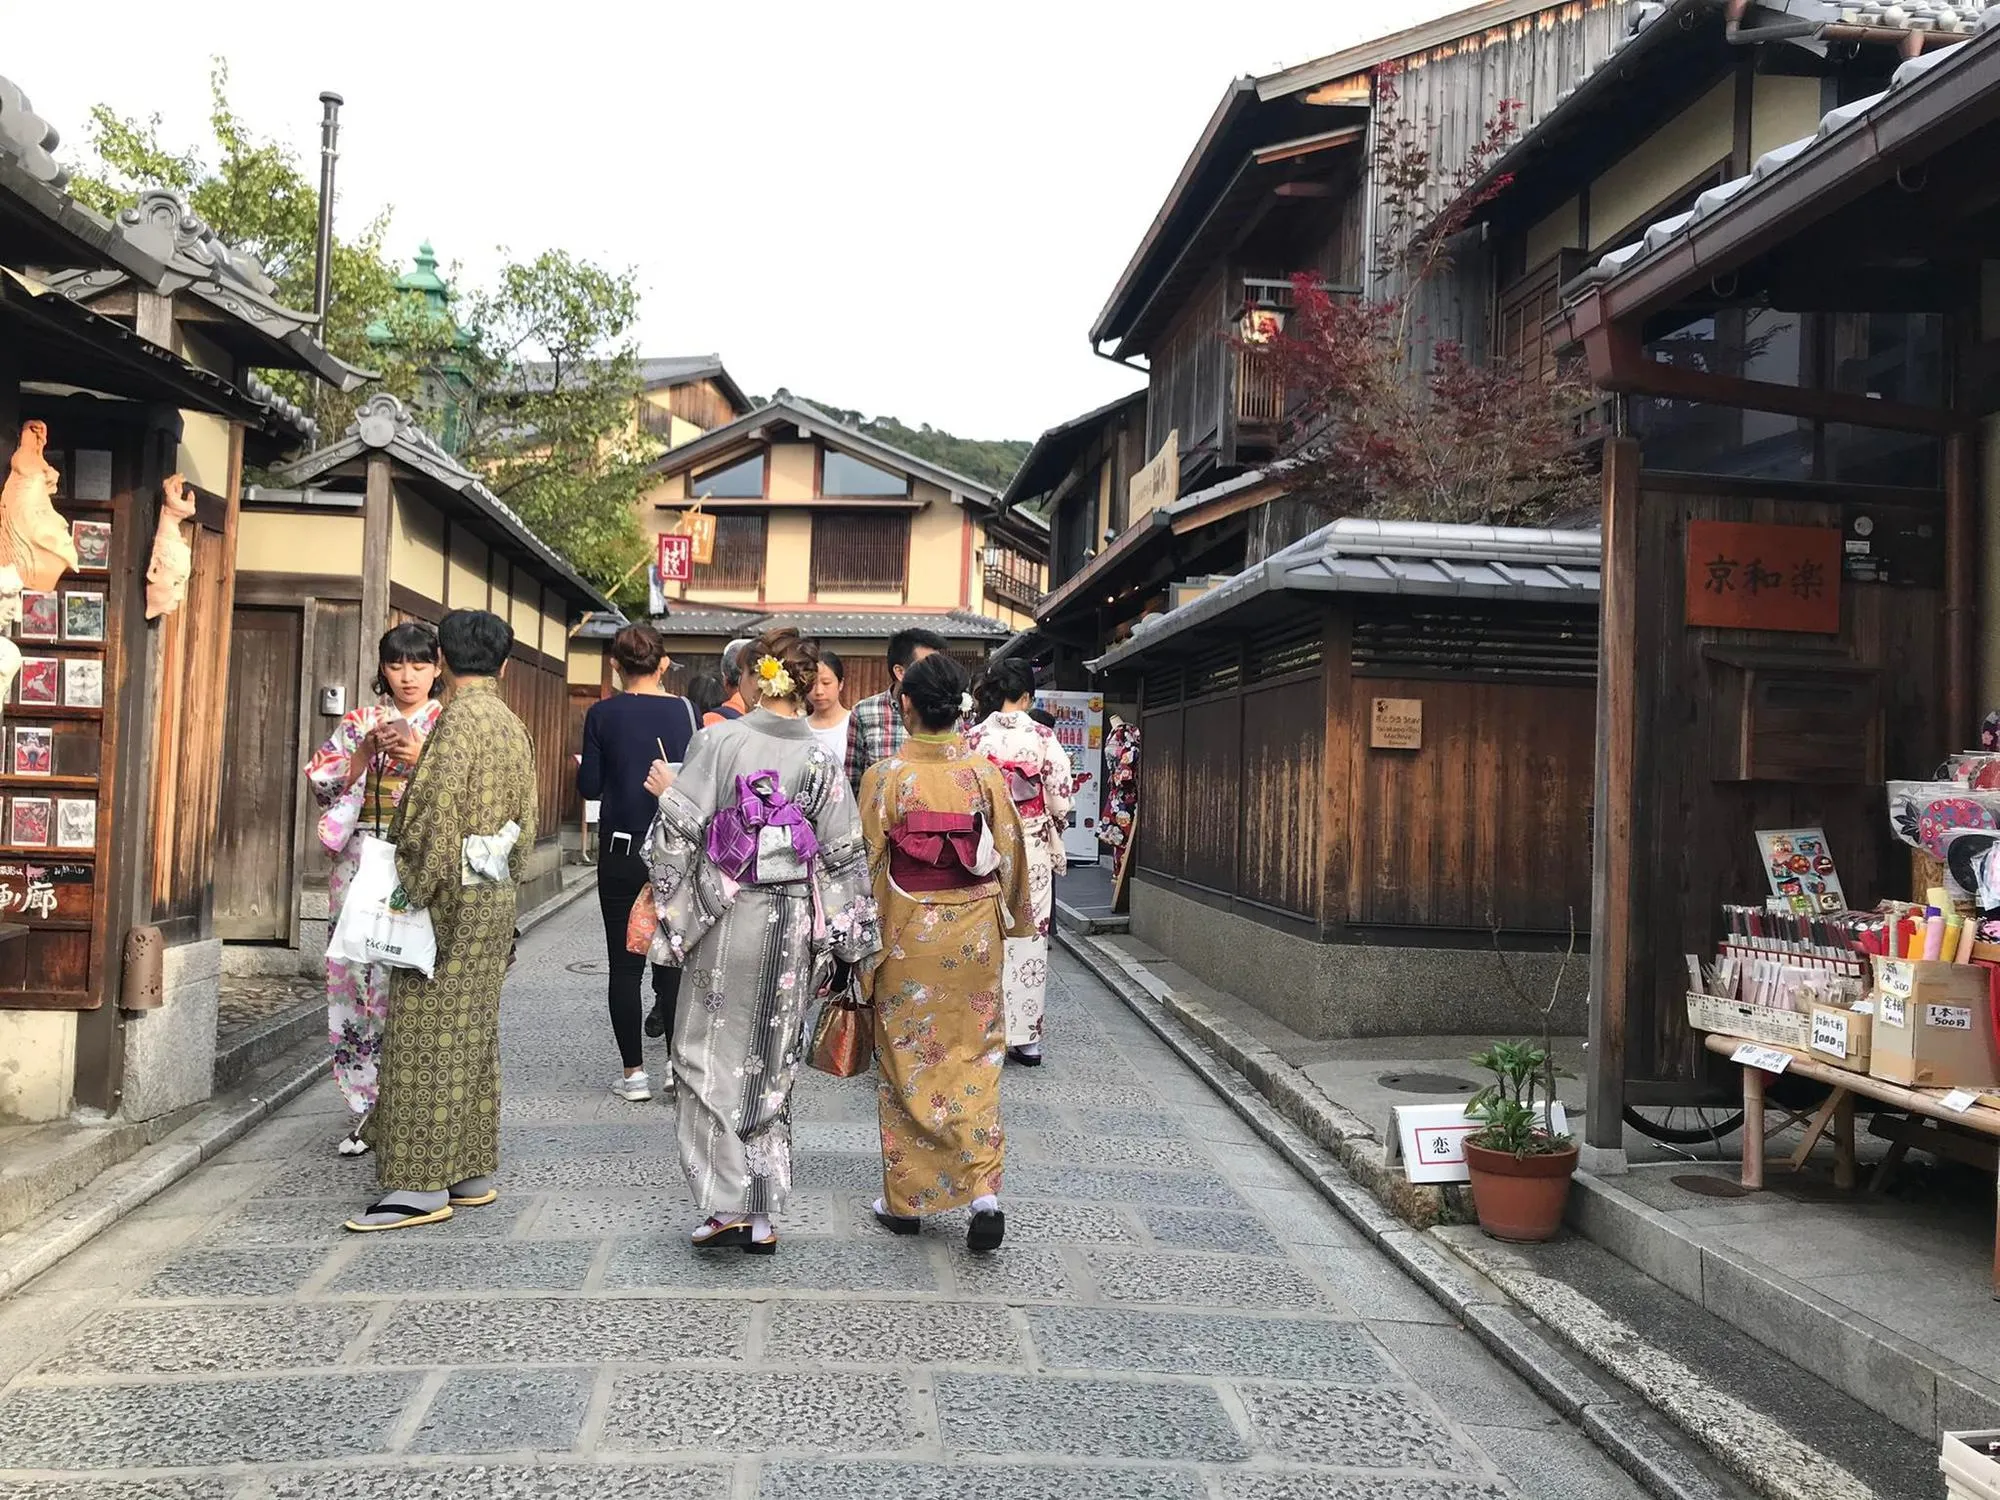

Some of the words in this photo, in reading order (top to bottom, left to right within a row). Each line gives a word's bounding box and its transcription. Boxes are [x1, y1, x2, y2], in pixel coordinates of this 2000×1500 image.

[1703, 554, 1824, 599] 京和楽
[1935, 1017, 1966, 1027] 500円
[1813, 1029, 1845, 1053] 1000円
[1432, 1136, 1450, 1154] 恋
